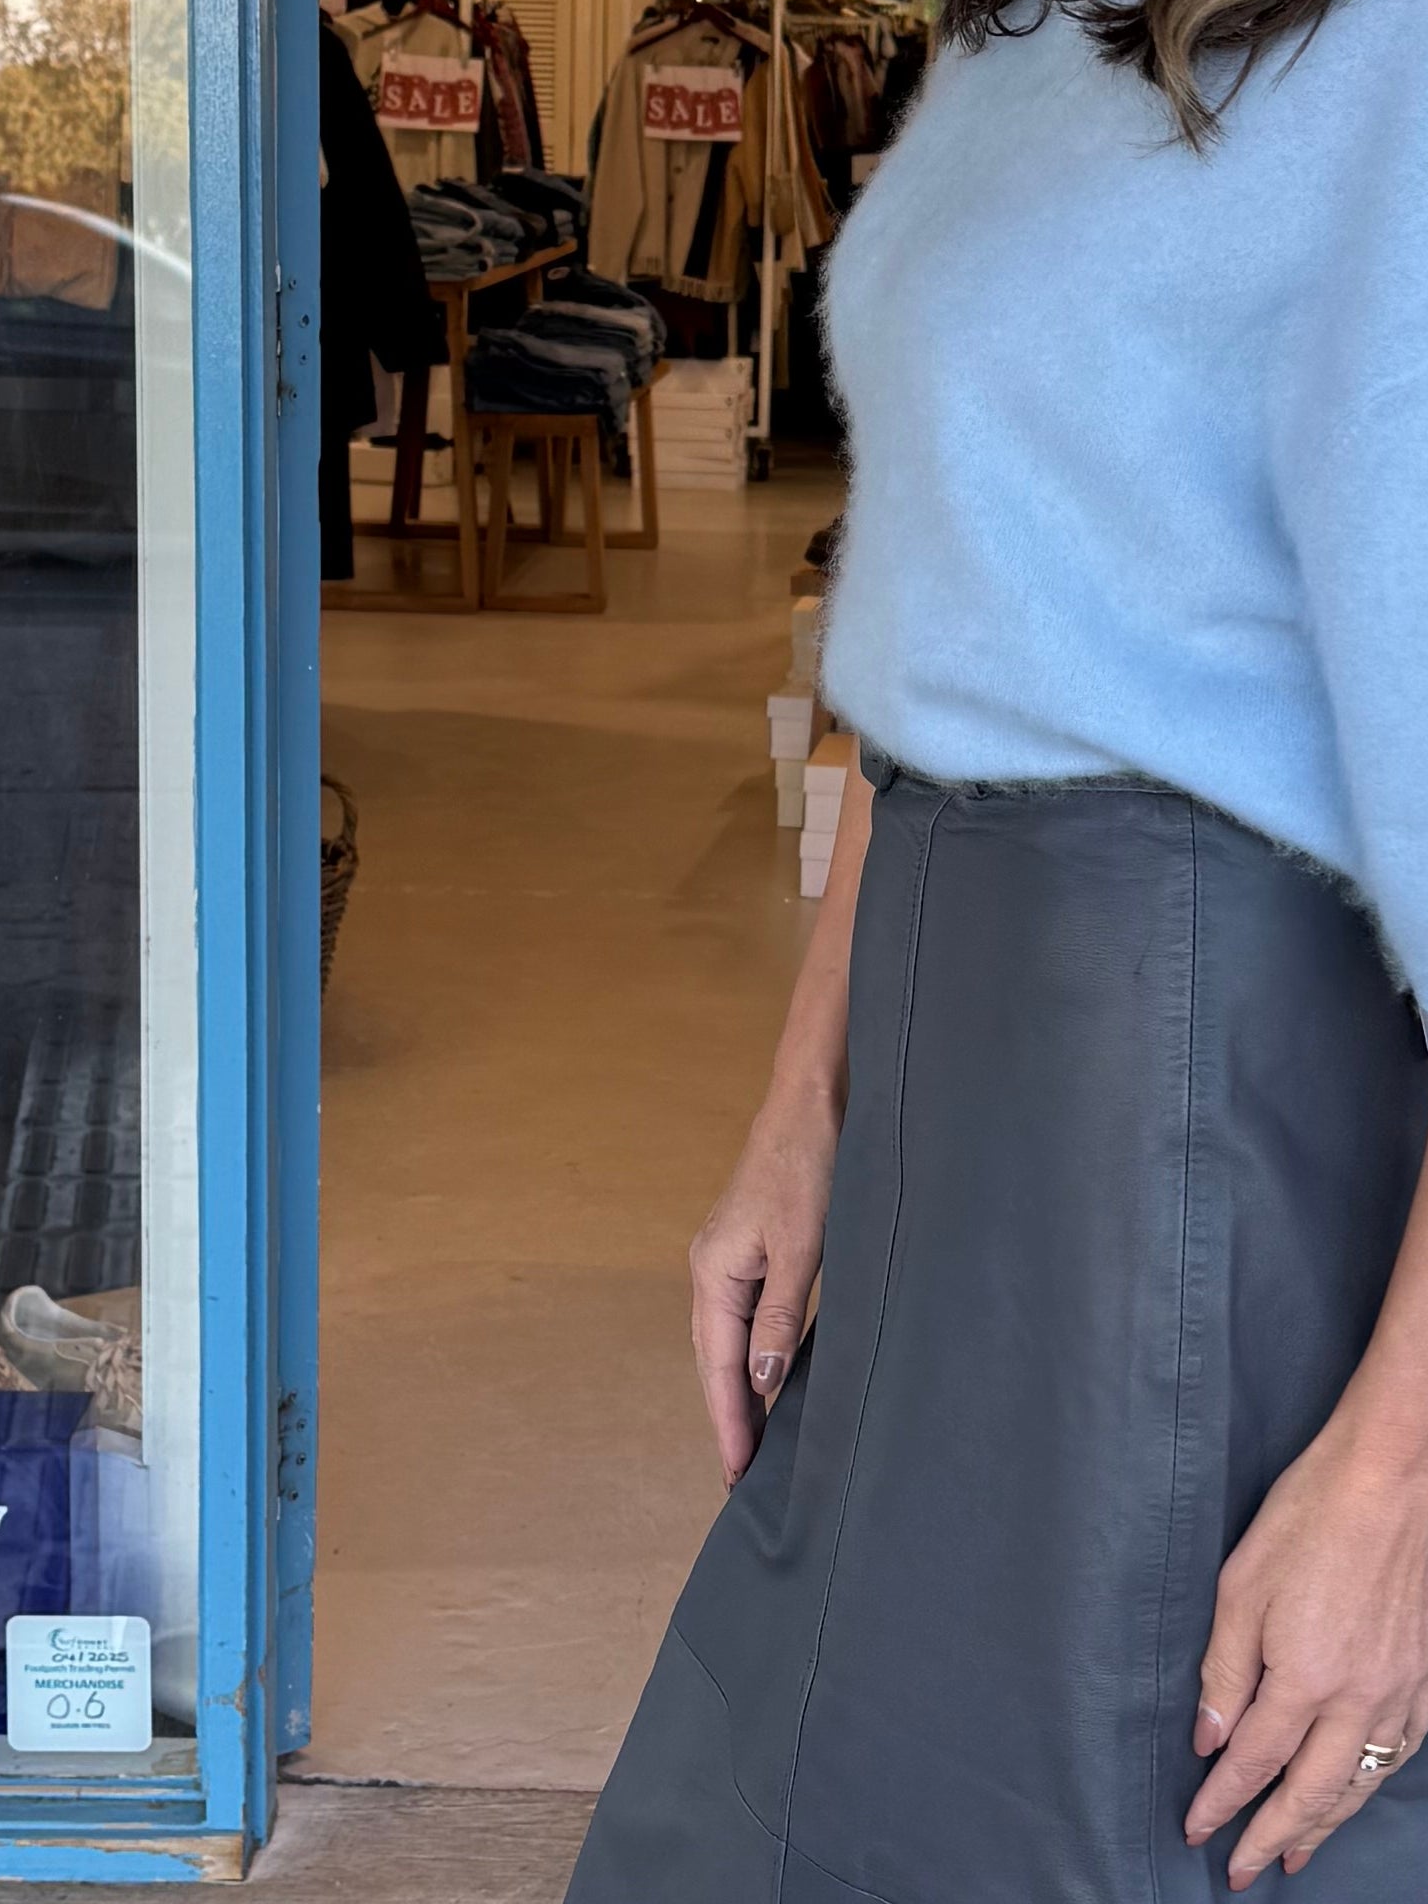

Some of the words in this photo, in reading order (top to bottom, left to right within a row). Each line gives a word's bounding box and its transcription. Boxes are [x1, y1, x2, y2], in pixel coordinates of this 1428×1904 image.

[385, 87, 475, 118] SALE
[648, 97, 739, 128] SALE
[34, 1678, 124, 1690] MERCHANDISE
[47, 1690, 105, 1720] 0.6
